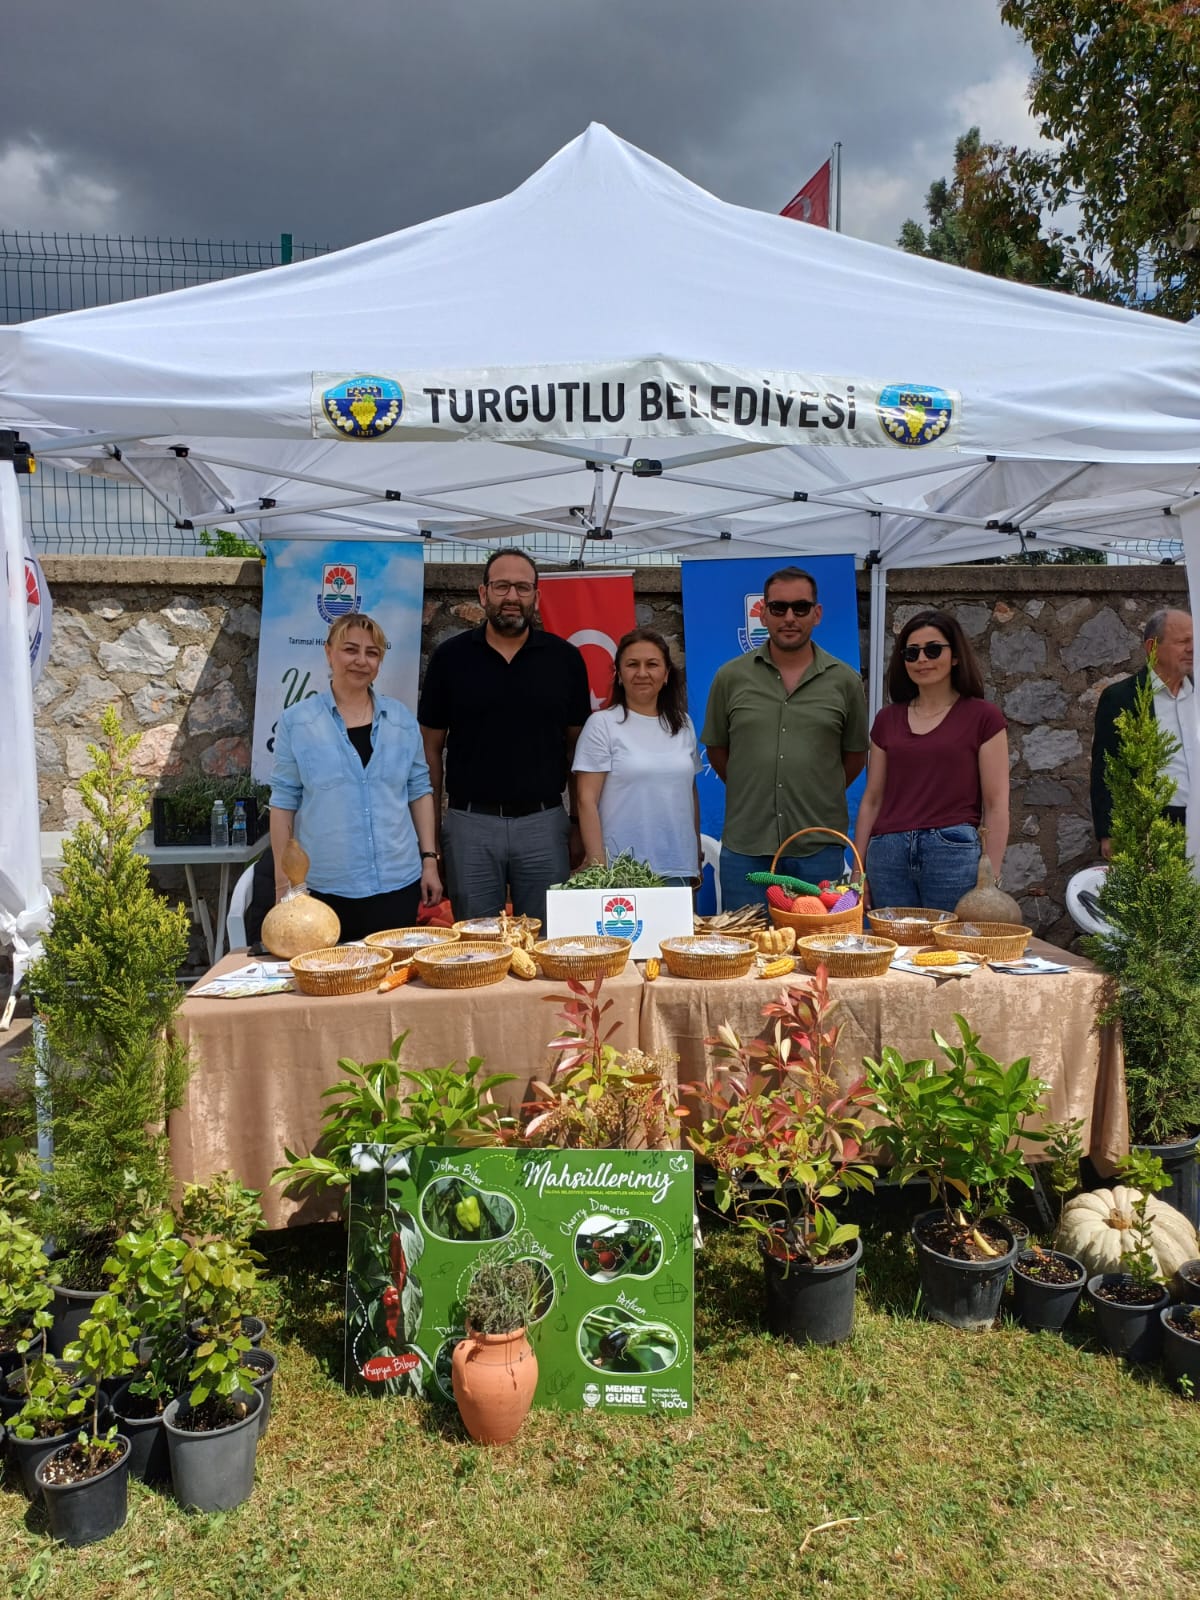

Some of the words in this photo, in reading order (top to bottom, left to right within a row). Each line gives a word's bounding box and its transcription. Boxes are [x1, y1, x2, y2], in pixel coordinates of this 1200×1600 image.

[423, 382, 625, 424] TURGUTLU
[639, 379, 856, 430] BELEDİYESİ
[429, 1157, 460, 1173] Dolma
[462, 1164, 484, 1186] Biber
[523, 1161, 674, 1204] Mahsüllerimiz
[560, 1208, 588, 1236] Cherry
[589, 1197, 630, 1216] Domates
[530, 1241, 555, 1260] Biber
[364, 1363, 391, 1381] Kapya
[391, 1357, 417, 1371] Biber
[605, 1384, 647, 1394] MEHMET
[605, 1392, 647, 1404] GÜREL
